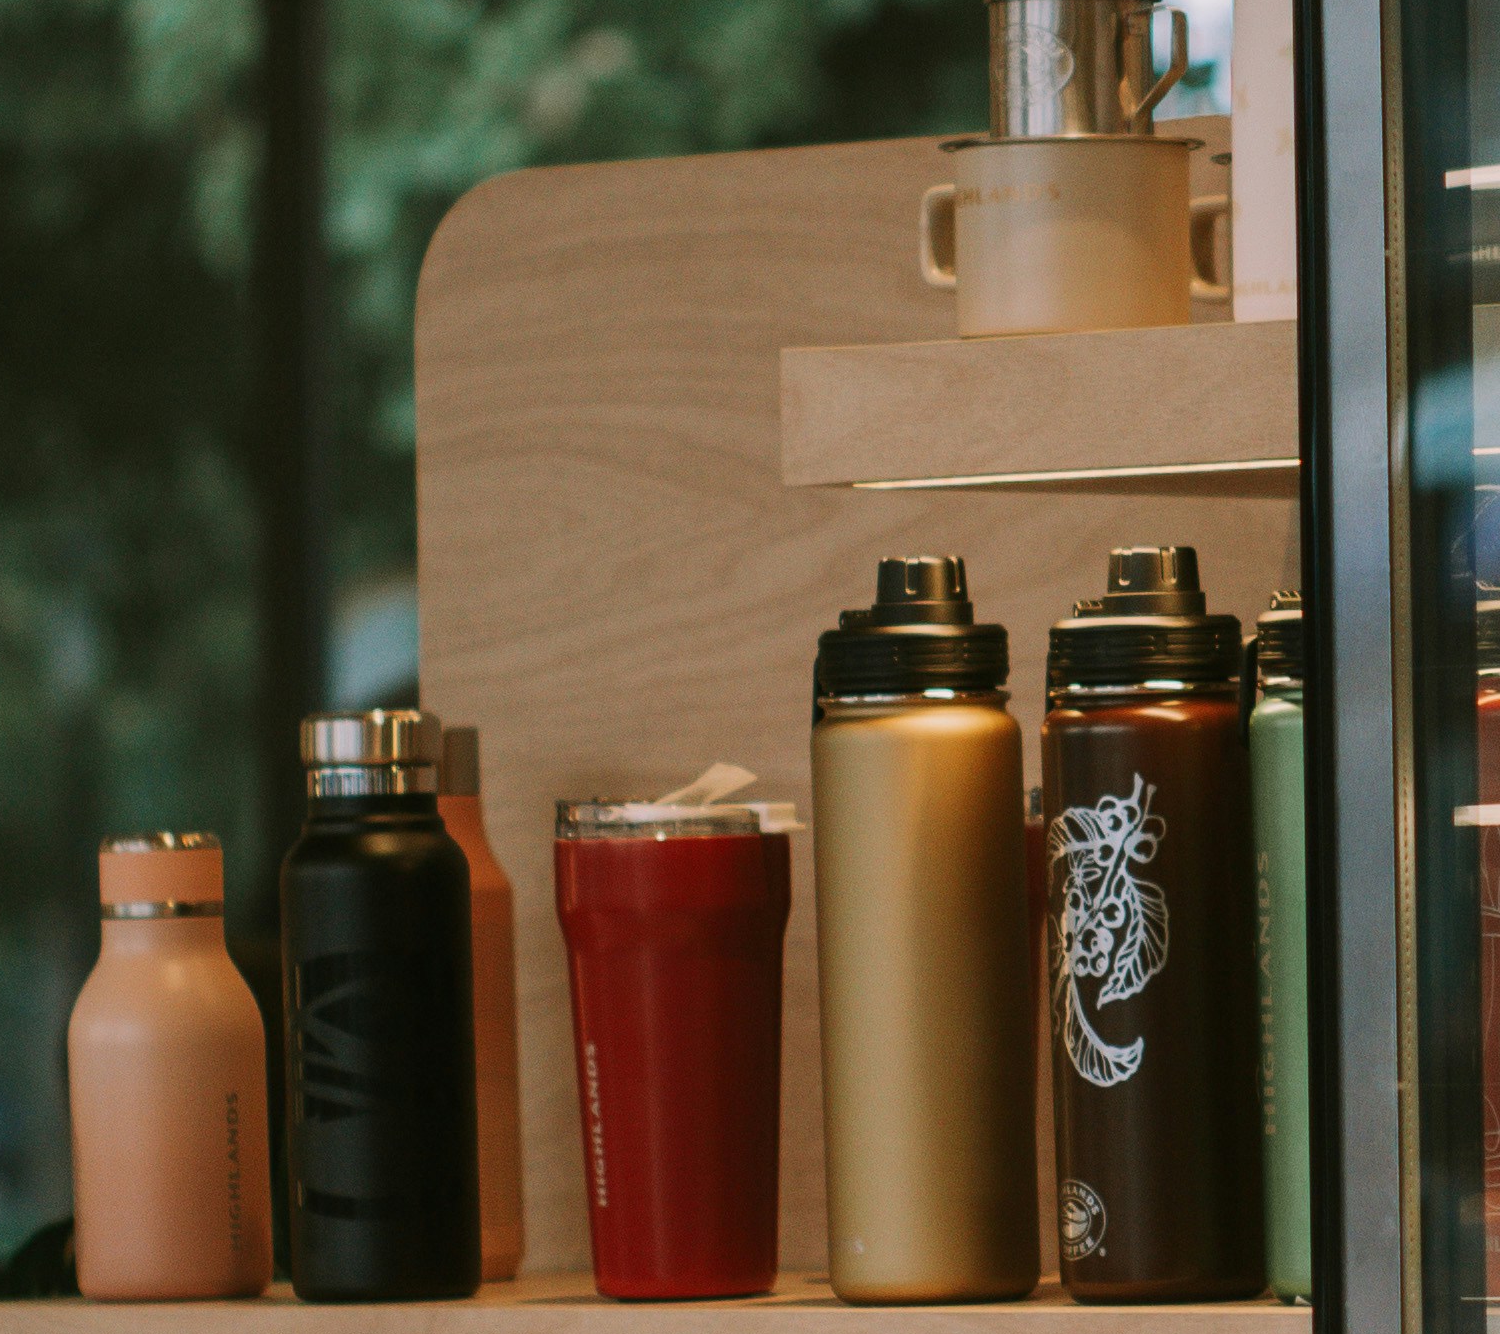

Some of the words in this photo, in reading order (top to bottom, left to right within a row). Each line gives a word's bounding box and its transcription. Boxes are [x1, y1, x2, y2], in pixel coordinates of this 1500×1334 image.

[1255, 851, 1277, 1136] HIGHLANDS
[226, 1091, 243, 1254] HIGHLANDS
[585, 1041, 608, 1208] HIGHLANDS
